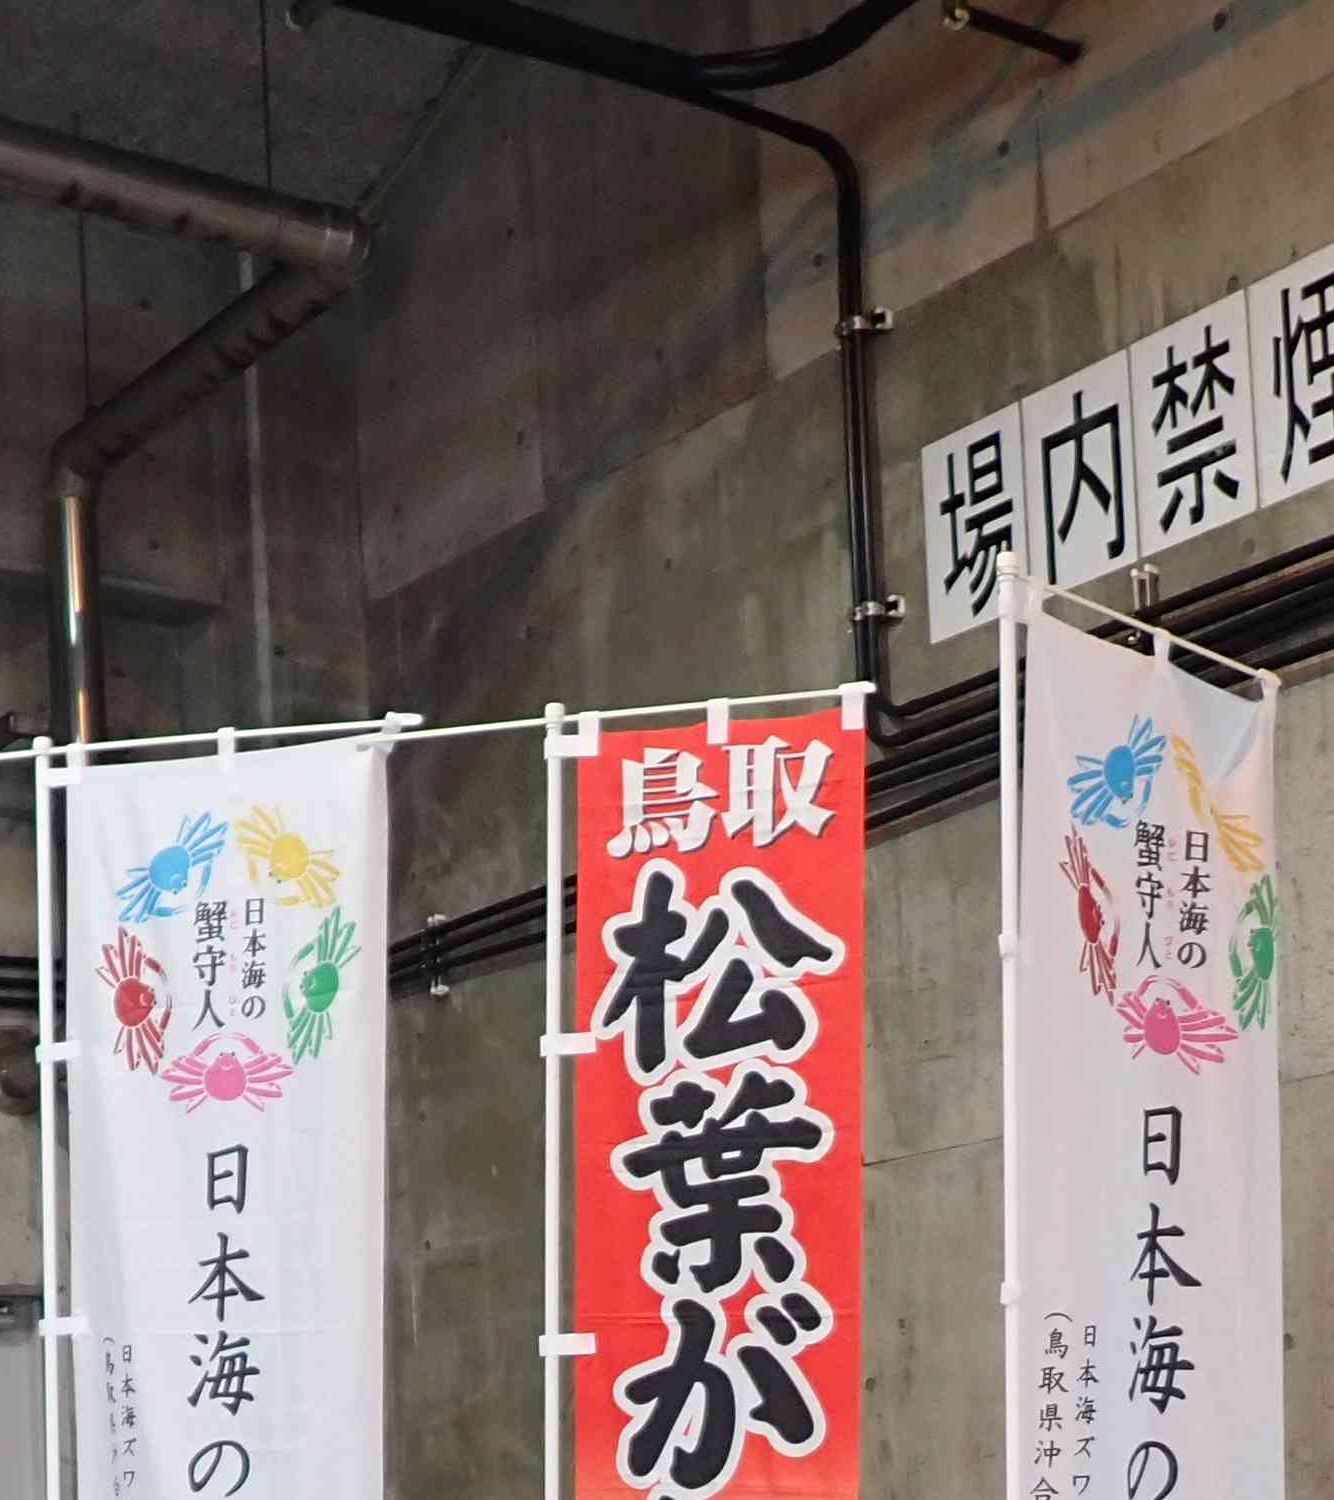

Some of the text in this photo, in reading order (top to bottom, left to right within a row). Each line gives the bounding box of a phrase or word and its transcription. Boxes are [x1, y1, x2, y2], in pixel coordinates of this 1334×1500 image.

[607, 742, 836, 857] 鳥取
[241, 897, 267, 1020] 日本海の
[1134, 819, 1165, 970] 蟹守人
[1177, 830, 1211, 970] 日本海の
[192, 901, 227, 1032] 蟹守人
